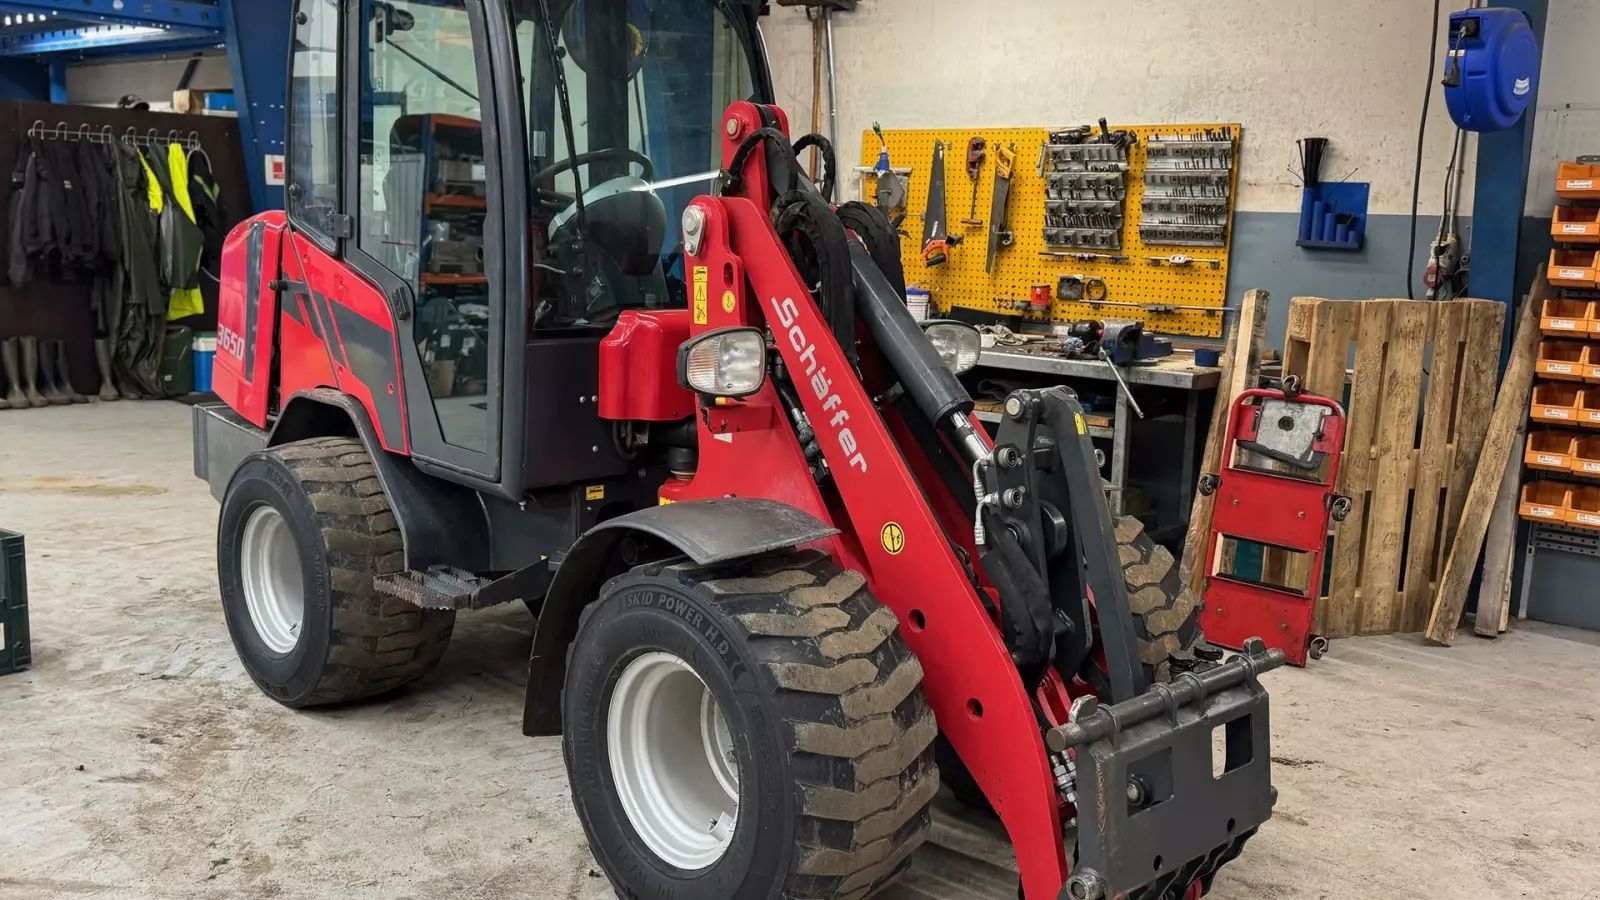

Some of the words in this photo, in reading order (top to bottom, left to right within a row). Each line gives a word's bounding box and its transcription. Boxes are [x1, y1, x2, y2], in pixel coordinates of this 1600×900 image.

[217, 323, 245, 361] 3650
[771, 296, 868, 474] Schäffer
[626, 591, 654, 606] SKID
[658, 593, 703, 629] POWER
